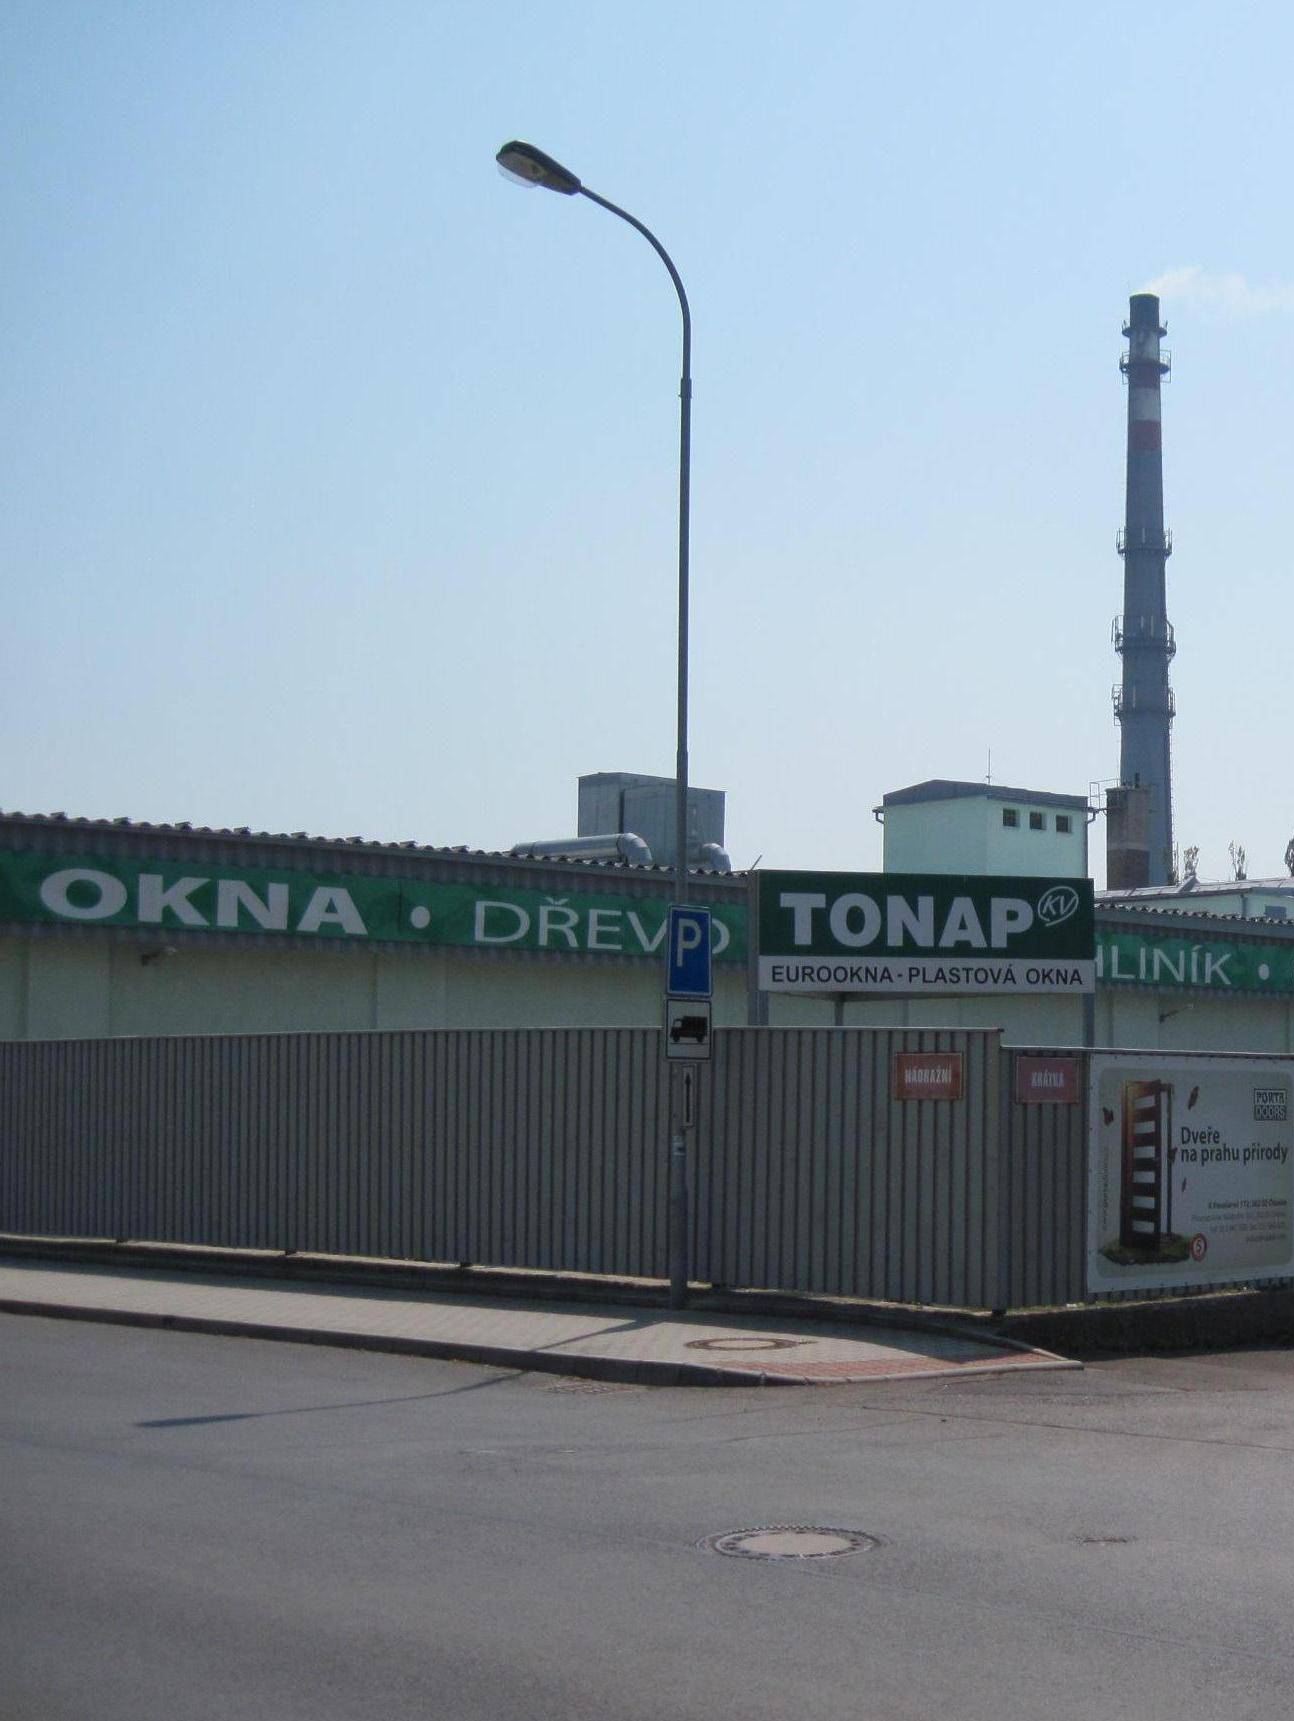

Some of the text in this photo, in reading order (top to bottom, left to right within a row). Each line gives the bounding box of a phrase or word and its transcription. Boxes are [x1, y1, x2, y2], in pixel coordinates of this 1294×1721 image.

[39, 868, 368, 935] OKNA
[780, 892, 1076, 949] TONAP KV
[676, 917, 702, 967] P
[771, 965, 893, 984] EUROOKNA
[908, 963, 1016, 986] PLASTOVÁ
[1026, 969, 1083, 986] OKNA
[1180, 1126, 1220, 1145] Dveře
[1180, 1148, 1198, 1162] na
[1201, 1143, 1240, 1166] prahu
